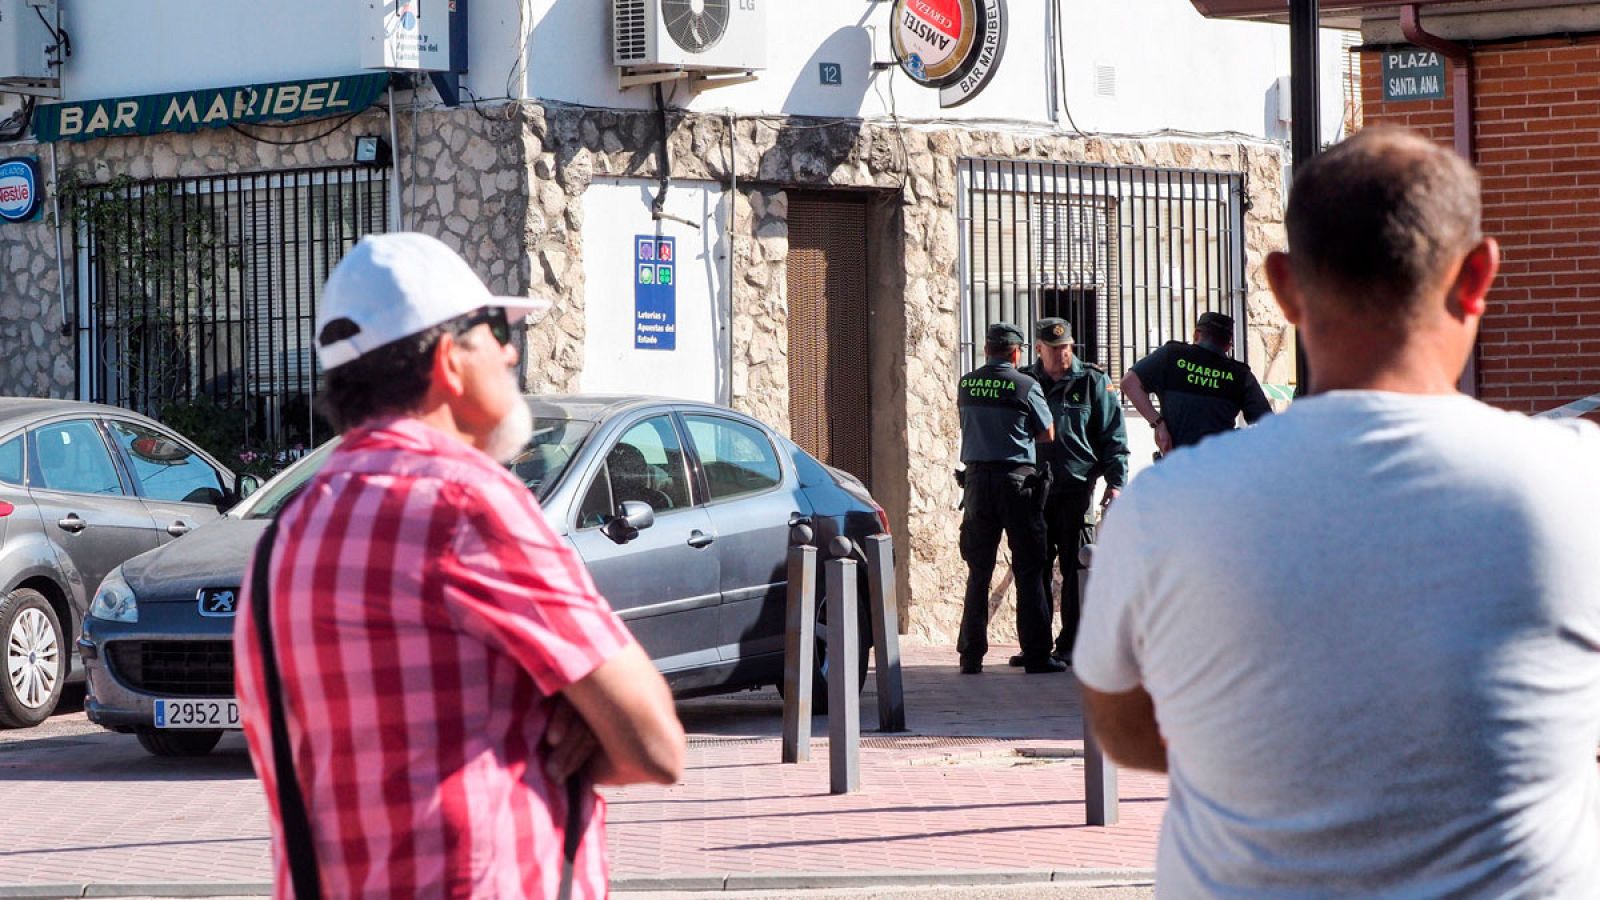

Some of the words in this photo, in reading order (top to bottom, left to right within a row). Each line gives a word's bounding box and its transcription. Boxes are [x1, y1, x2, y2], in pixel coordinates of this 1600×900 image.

[739, 0, 755, 10] LG
[915, 0, 953, 29] CERVEZA
[904, 11, 950, 50] AMSTEL
[959, 67, 983, 93] BAR
[980, 0, 998, 67] MARIBEL
[1389, 52, 1439, 69] PLAZA
[823, 66, 837, 82] 12
[1389, 77, 1417, 96] SANTA
[1420, 76, 1439, 94] ANA
[59, 102, 139, 136] BAR
[161, 81, 349, 125] MARIBEL
[0, 166, 25, 177] ELADOS
[662, 313, 666, 321] y
[637, 323, 664, 333] Apuestas
[665, 324, 674, 332] del
[637, 335, 658, 344] Estado
[1176, 359, 1234, 381] GUARDIA
[960, 378, 1016, 391] GUARDIA
[1187, 374, 1220, 389] CIVIL
[970, 388, 1000, 398] CIVIL
[170, 703, 220, 724] 2952
